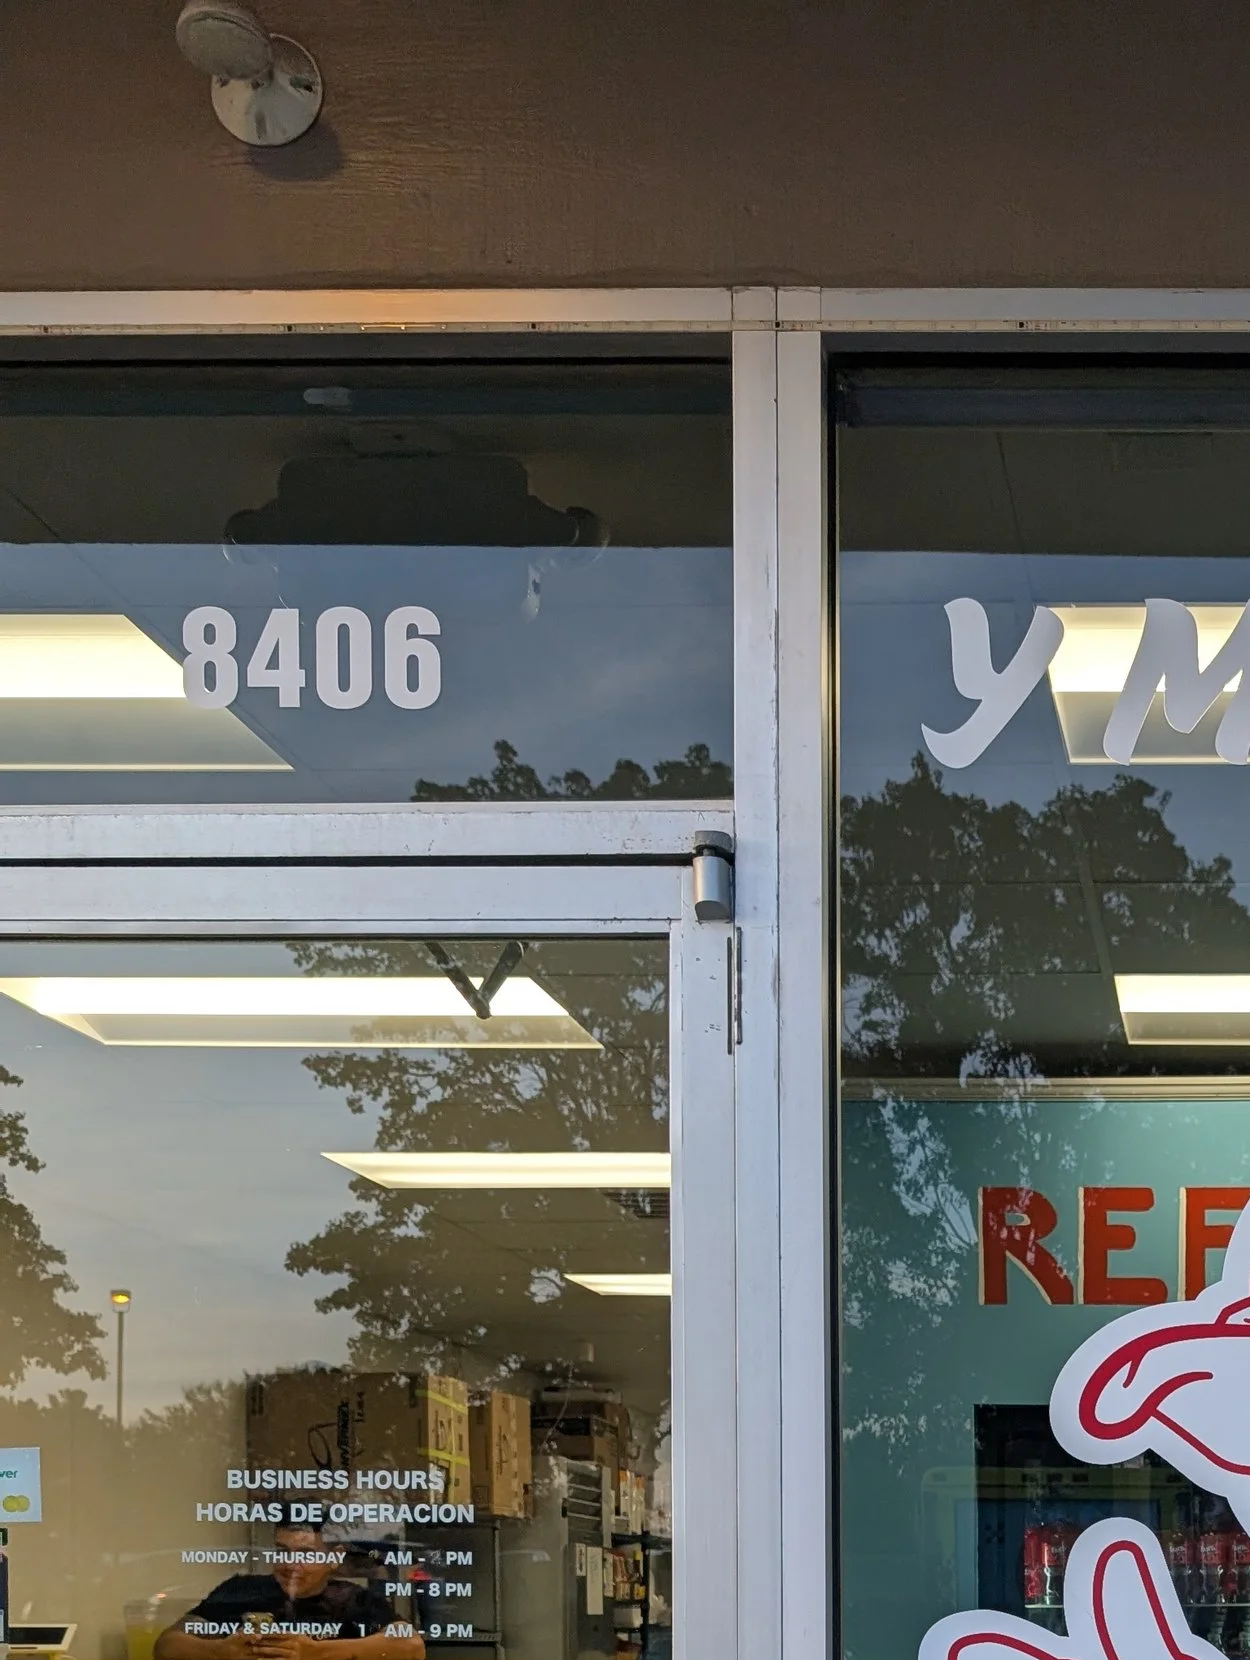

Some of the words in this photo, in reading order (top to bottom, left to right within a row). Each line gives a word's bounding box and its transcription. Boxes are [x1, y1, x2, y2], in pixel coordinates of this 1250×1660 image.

[183, 605, 442, 710] 8406
[921, 597, 1064, 768] Y
[226, 1469, 349, 1491] BUSINESS
[356, 1470, 445, 1491] HOURS
[196, 1502, 283, 1523] HORAS
[290, 1503, 323, 1523] DE
[329, 1503, 475, 1524] OPERACION
[181, 1550, 249, 1564] MONDAY
[262, 1550, 346, 1565] THURSDAY
[384, 1551, 413, 1566] AM
[446, 1551, 473, 1566] PM
[385, 1582, 412, 1597] PM
[428, 1582, 441, 1597] 8
[445, 1582, 472, 1597] PM
[184, 1622, 240, 1635] FRIDAY
[243, 1622, 255, 1636] &
[260, 1622, 343, 1636] SATURDAY
[384, 1623, 413, 1638] AM
[429, 1623, 442, 1638] 9
[446, 1623, 473, 1638] PM
